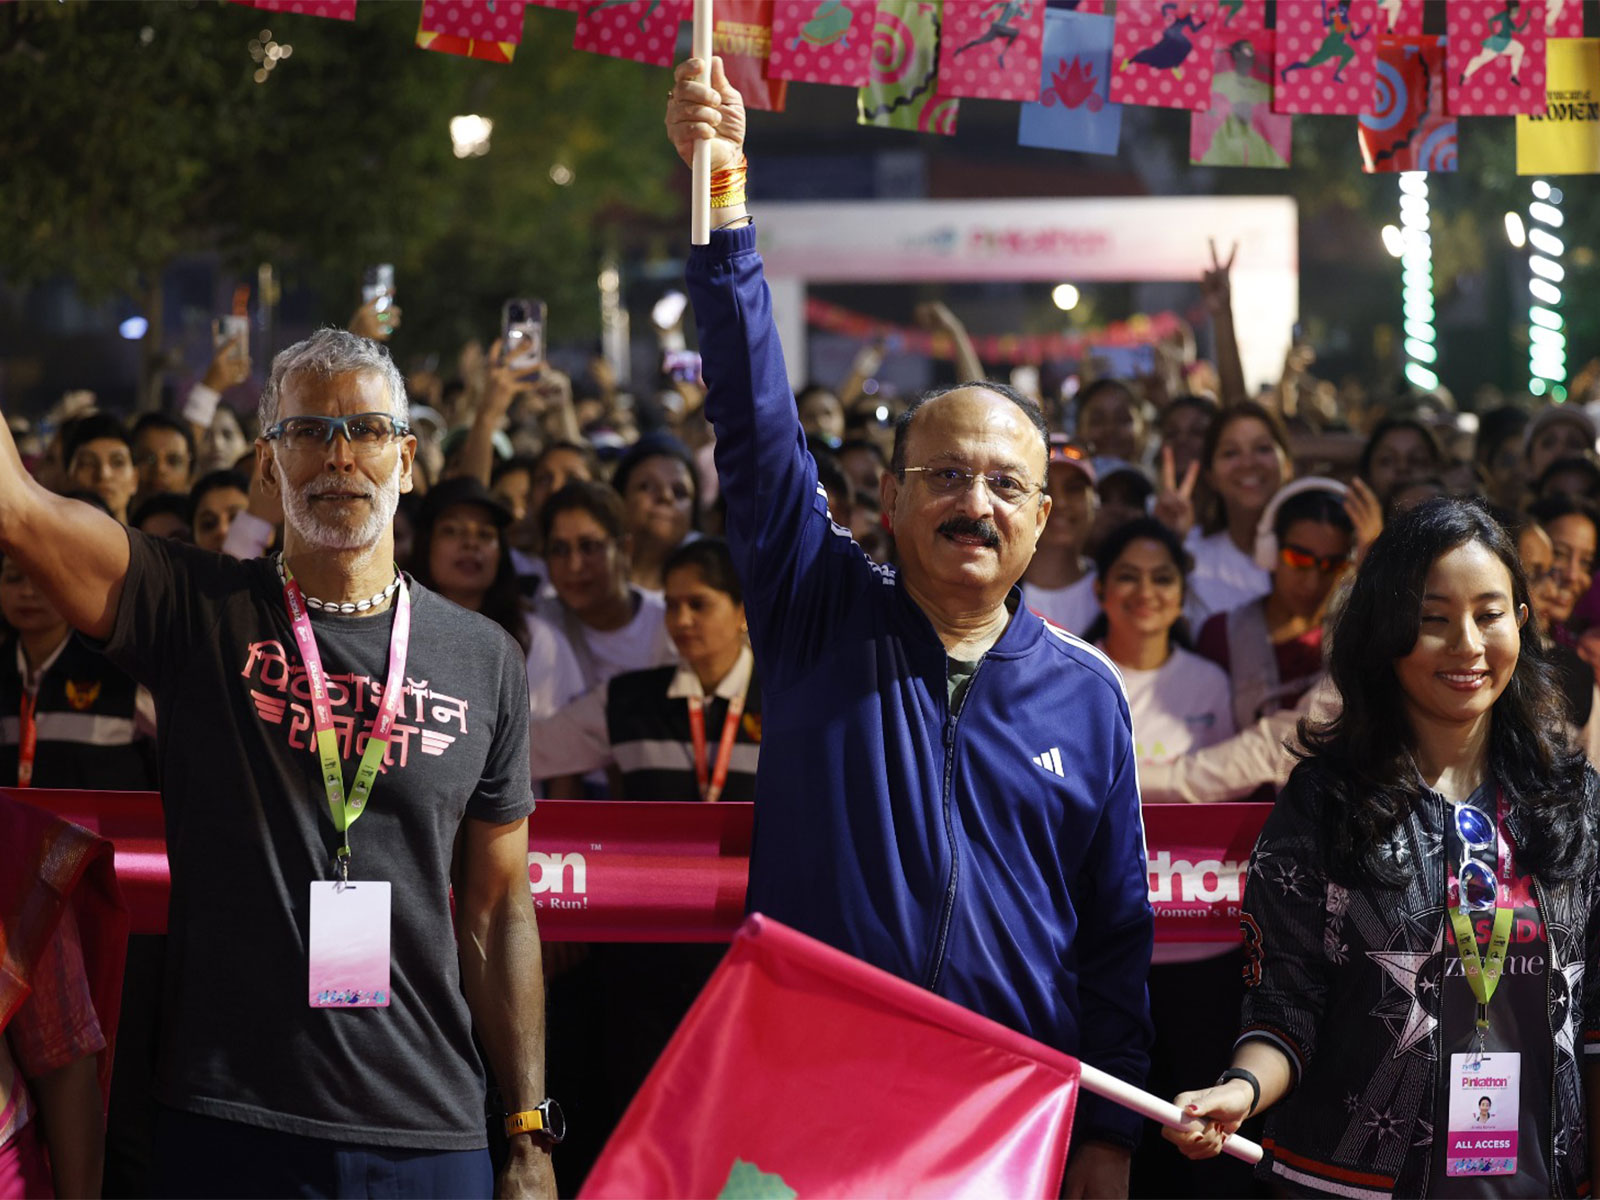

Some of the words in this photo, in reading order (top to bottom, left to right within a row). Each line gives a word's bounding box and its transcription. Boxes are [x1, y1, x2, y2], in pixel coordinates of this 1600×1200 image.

[550, 897, 589, 910] Run!
[1455, 1140, 1473, 1149] ALL
[1475, 1140, 1511, 1149] ACCESS
